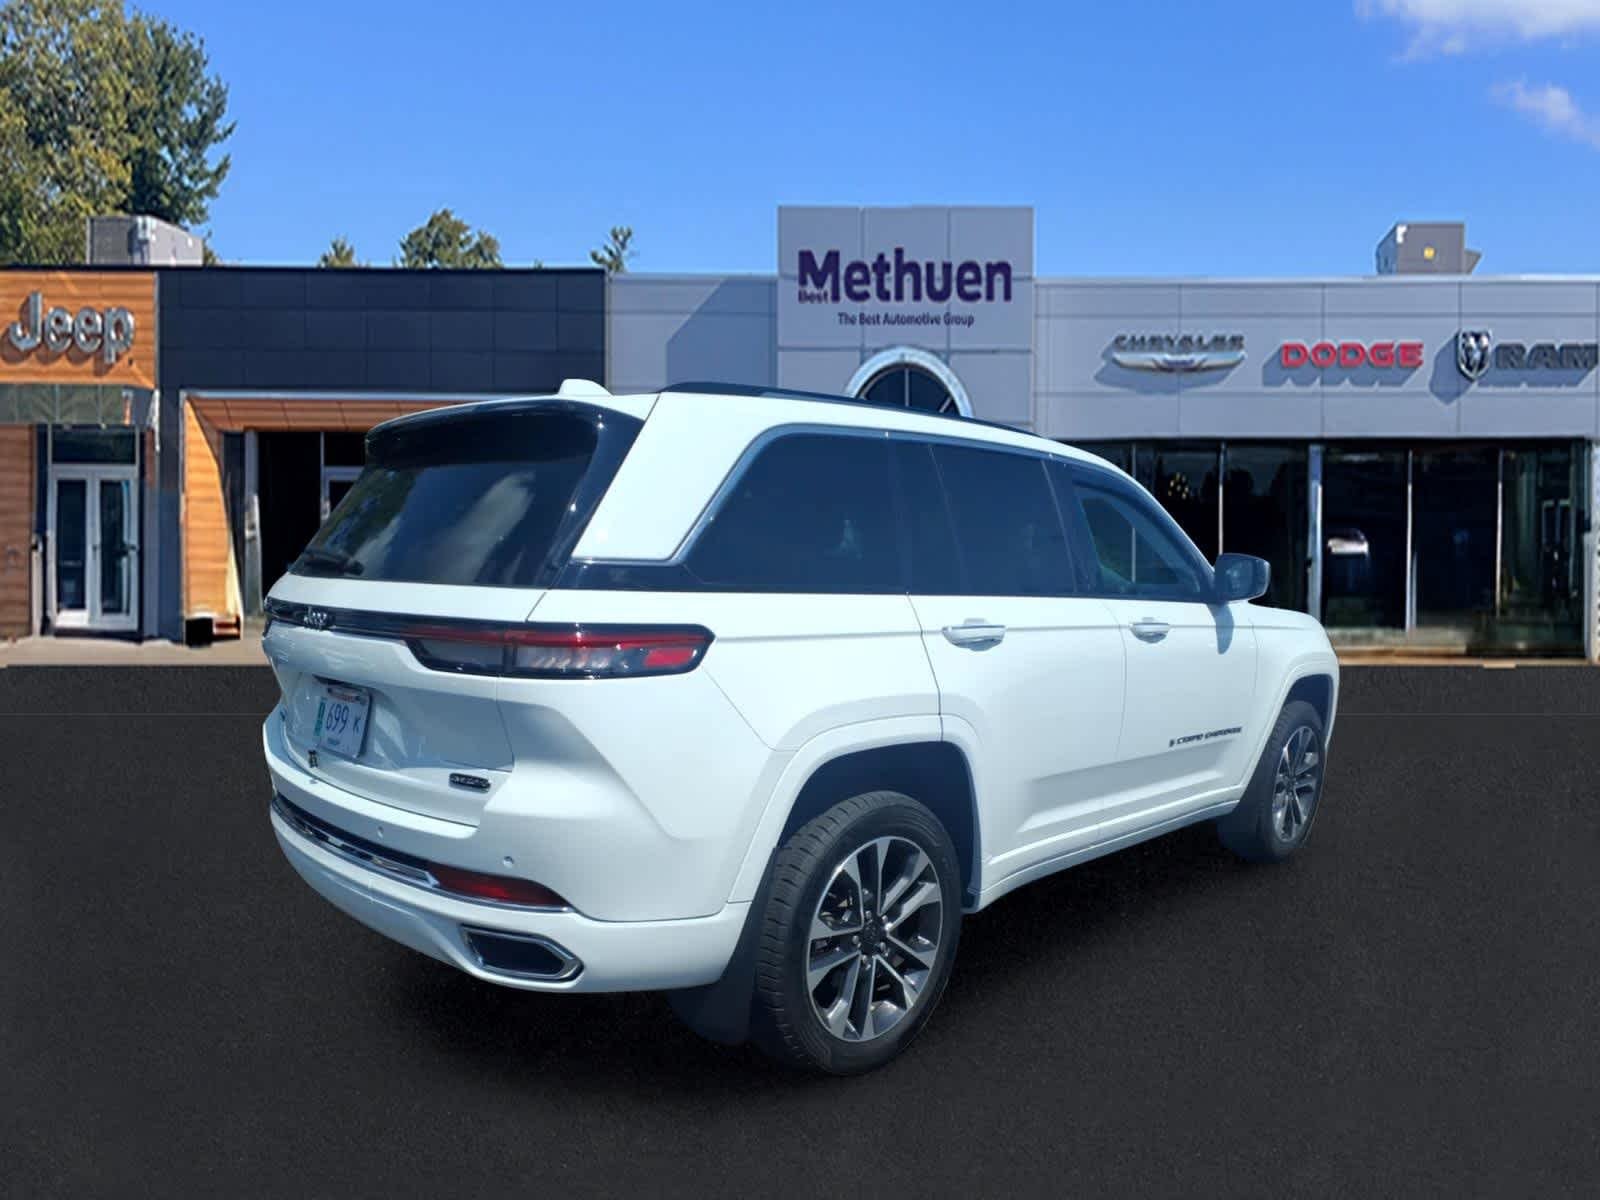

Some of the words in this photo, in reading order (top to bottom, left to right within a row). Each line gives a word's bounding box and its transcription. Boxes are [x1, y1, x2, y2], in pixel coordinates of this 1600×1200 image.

[798, 247, 1012, 302] Methuen
[798, 289, 829, 304] Best
[9, 291, 135, 364] Jeep
[838, 312, 856, 325] The
[859, 312, 880, 325] Best
[883, 312, 941, 325] Automotive
[943, 312, 975, 328] Group
[1113, 334, 1245, 352] CHRYSLER
[1282, 342, 1423, 368] DODGE
[1495, 343, 1598, 369] RAM
